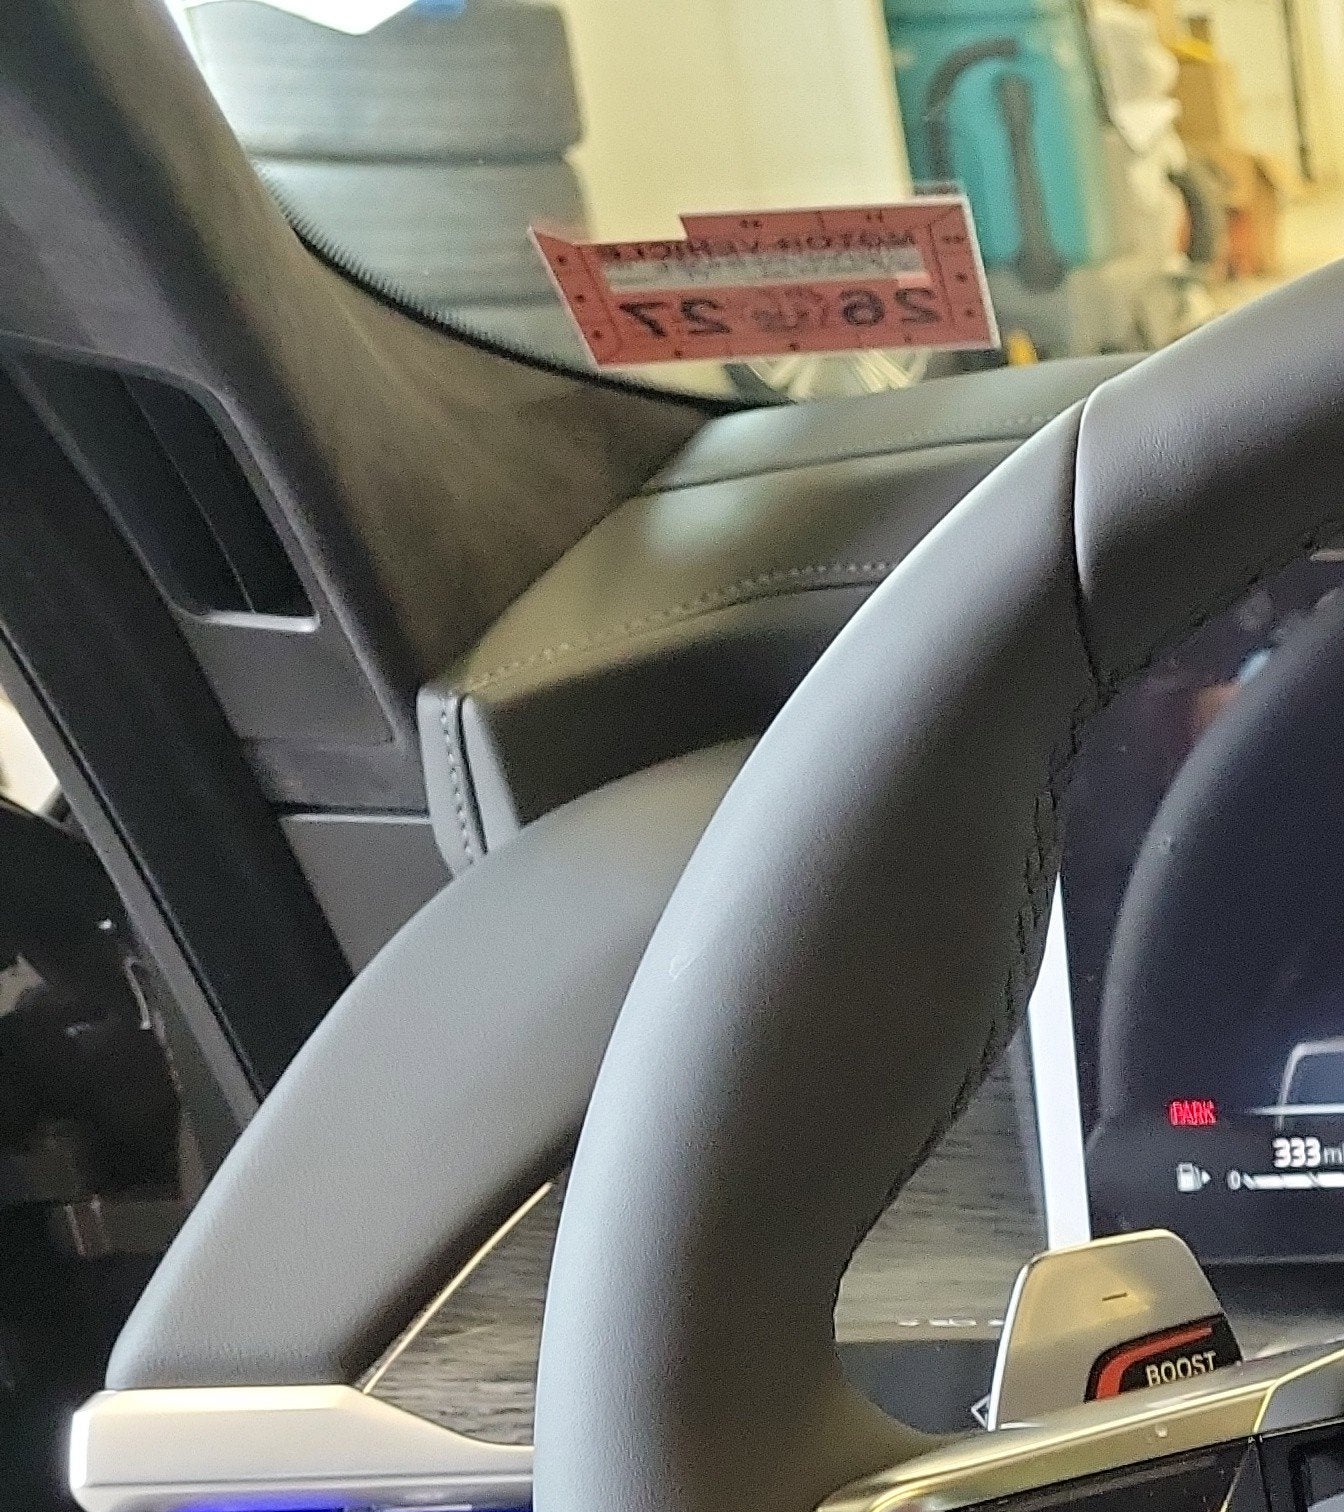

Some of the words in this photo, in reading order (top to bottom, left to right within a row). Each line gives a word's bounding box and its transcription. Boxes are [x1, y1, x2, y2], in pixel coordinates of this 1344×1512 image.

[1169, 1099, 1218, 1126] PARK
[1271, 1136, 1322, 1169] 333
[1145, 1350, 1218, 1386] BOOST
